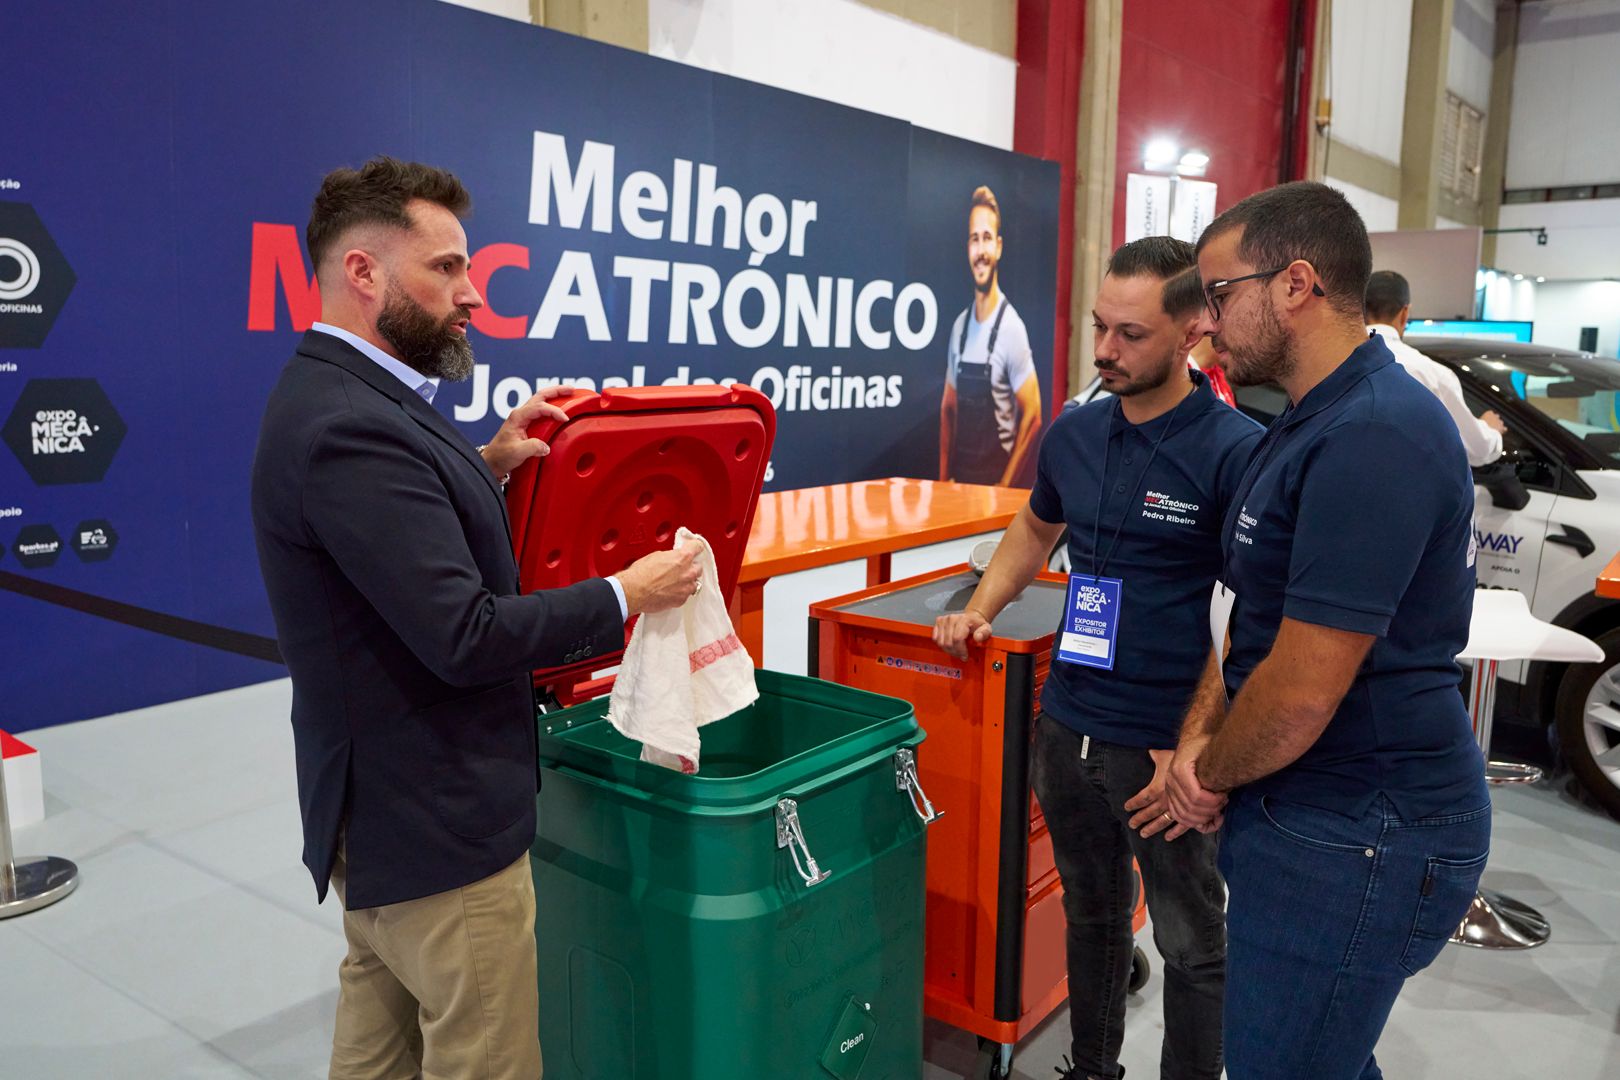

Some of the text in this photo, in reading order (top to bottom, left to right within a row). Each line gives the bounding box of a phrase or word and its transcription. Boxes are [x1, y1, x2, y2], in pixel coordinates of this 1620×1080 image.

[528, 130, 817, 257] Melhor
[247, 221, 938, 350] MCATRÓNICO
[750, 365, 902, 412] Oficinas
[35, 410, 77, 423] expo
[32, 436, 86, 454] NICA
[1146, 490, 1170, 500] Melhor
[1144, 496, 1199, 511] MECATRÓNICO
[1142, 510, 1196, 525] Pedro Ribeiro
[1477, 531, 1524, 554] WAY
[1080, 585, 1100, 594] expo
[1076, 601, 1102, 613] NICA
[1074, 617, 1107, 628] EXPOSITOR
[1075, 625, 1105, 636] EXHIBITOR
[840, 1033, 864, 1054] Clean
